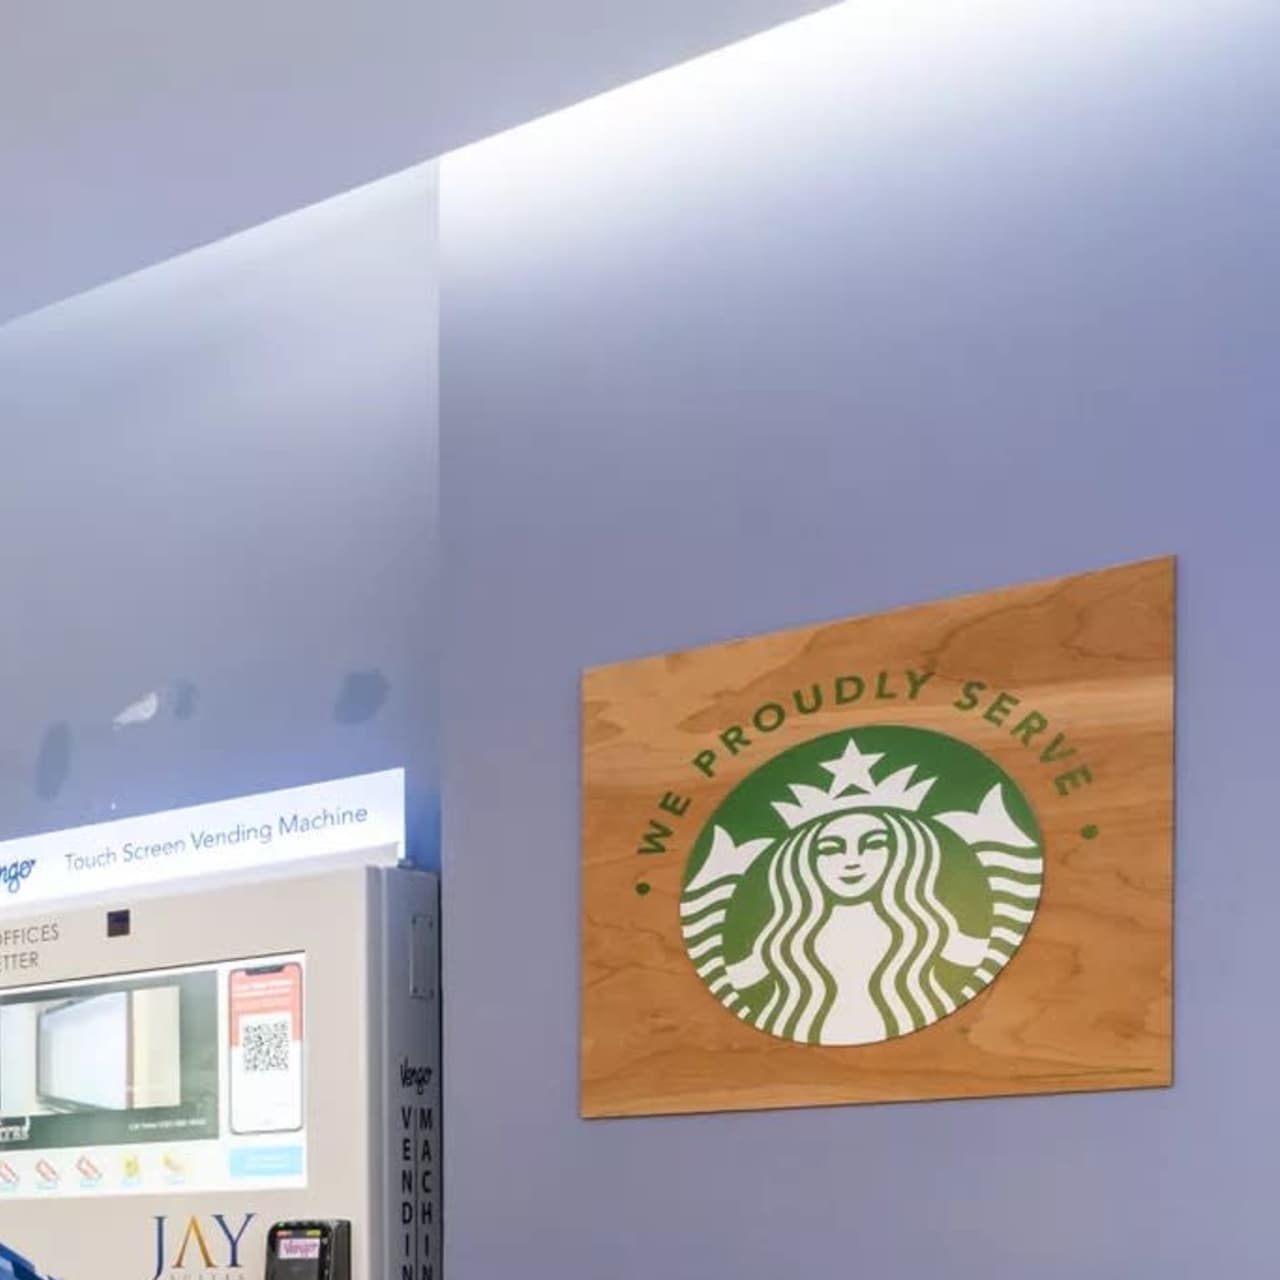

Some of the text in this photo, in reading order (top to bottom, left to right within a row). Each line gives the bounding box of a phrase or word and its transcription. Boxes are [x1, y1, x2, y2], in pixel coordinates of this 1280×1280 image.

[637, 669, 1095, 857] WE PROUDLY SERVE
[64, 849, 117, 872] Touch
[123, 837, 186, 864] Screen
[190, 823, 272, 851] Vending
[278, 804, 369, 836] Machine
